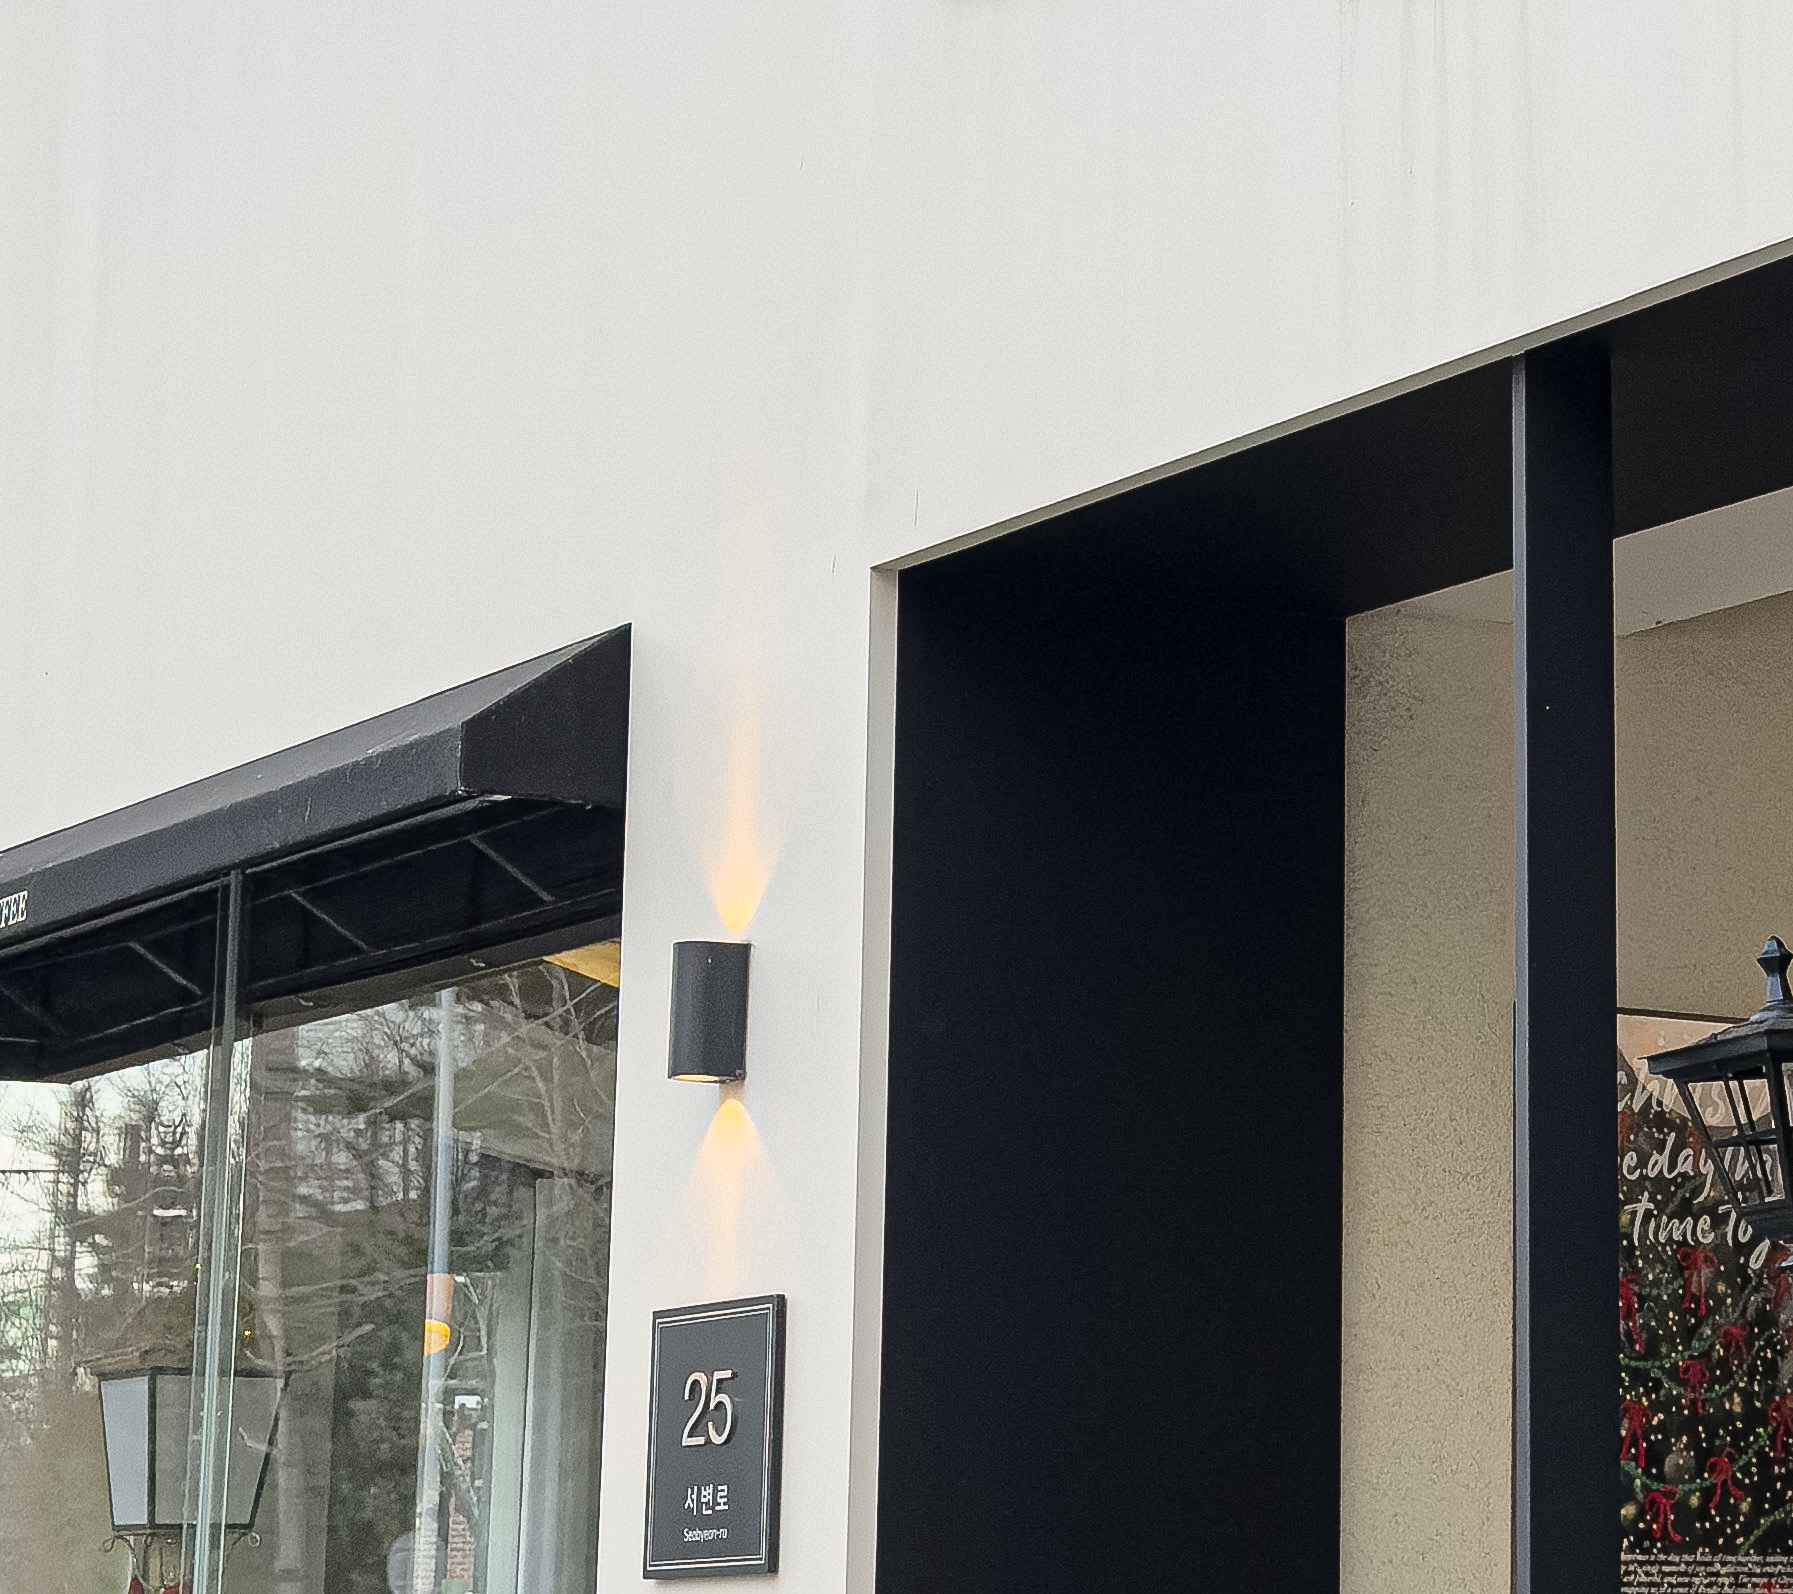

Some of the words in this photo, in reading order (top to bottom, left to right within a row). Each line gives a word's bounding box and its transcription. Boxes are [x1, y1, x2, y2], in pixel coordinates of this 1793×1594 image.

[0, 890, 28, 928] FEE
[681, 1369, 732, 1446] 25
[685, 1483, 729, 1516] 서변로
